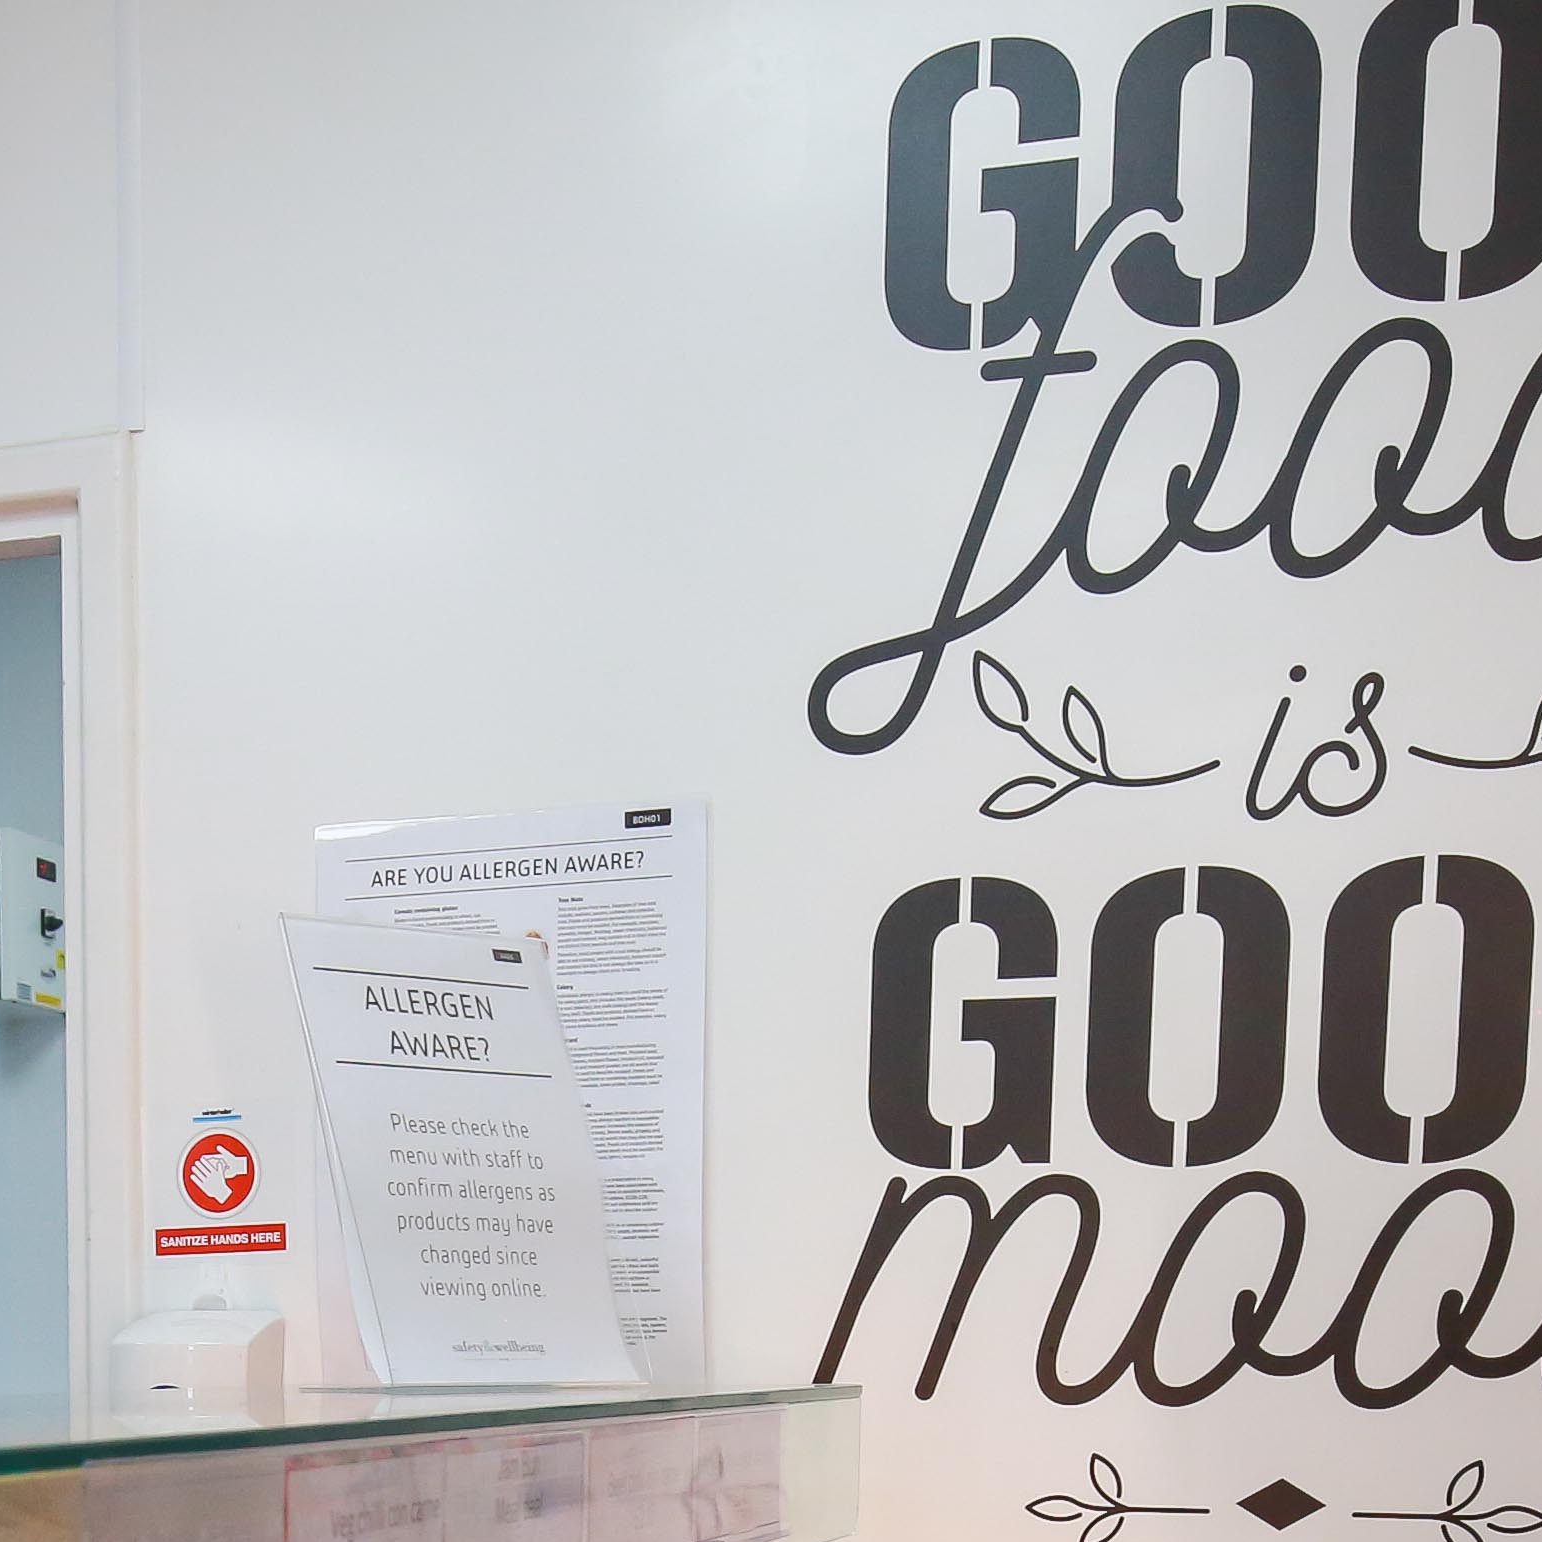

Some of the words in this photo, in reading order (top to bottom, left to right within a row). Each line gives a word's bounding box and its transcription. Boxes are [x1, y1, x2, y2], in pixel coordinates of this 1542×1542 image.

[1246, 665, 1387, 821] is
[371, 869, 407, 888] ARE
[413, 865, 454, 885] YOU
[459, 857, 558, 881] ALLERGEN
[564, 850, 645, 874] AWARE?
[365, 985, 494, 1020] ALLERGEN
[390, 1030, 490, 1061] AWARE?
[390, 1113, 447, 1135] Please
[451, 1118, 499, 1137] check
[503, 1120, 530, 1139] the
[390, 1149, 438, 1166] menu
[442, 1147, 480, 1167] with
[485, 1149, 523, 1168] staff
[527, 1152, 544, 1170] to
[387, 1177, 453, 1198] confirm
[459, 1180, 533, 1204] allergens
[538, 1187, 556, 1201] as
[397, 1210, 470, 1233] products
[476, 1216, 510, 1237] may
[516, 1213, 554, 1234] have
[160, 1235, 209, 1248] SANITIZE
[210, 1233, 249, 1246] HANDS
[250, 1231, 282, 1244] HERE
[420, 1243, 491, 1269] changed
[497, 1246, 538, 1266] since
[420, 1276, 487, 1302] viewing
[491, 1278, 547, 1298] online.
